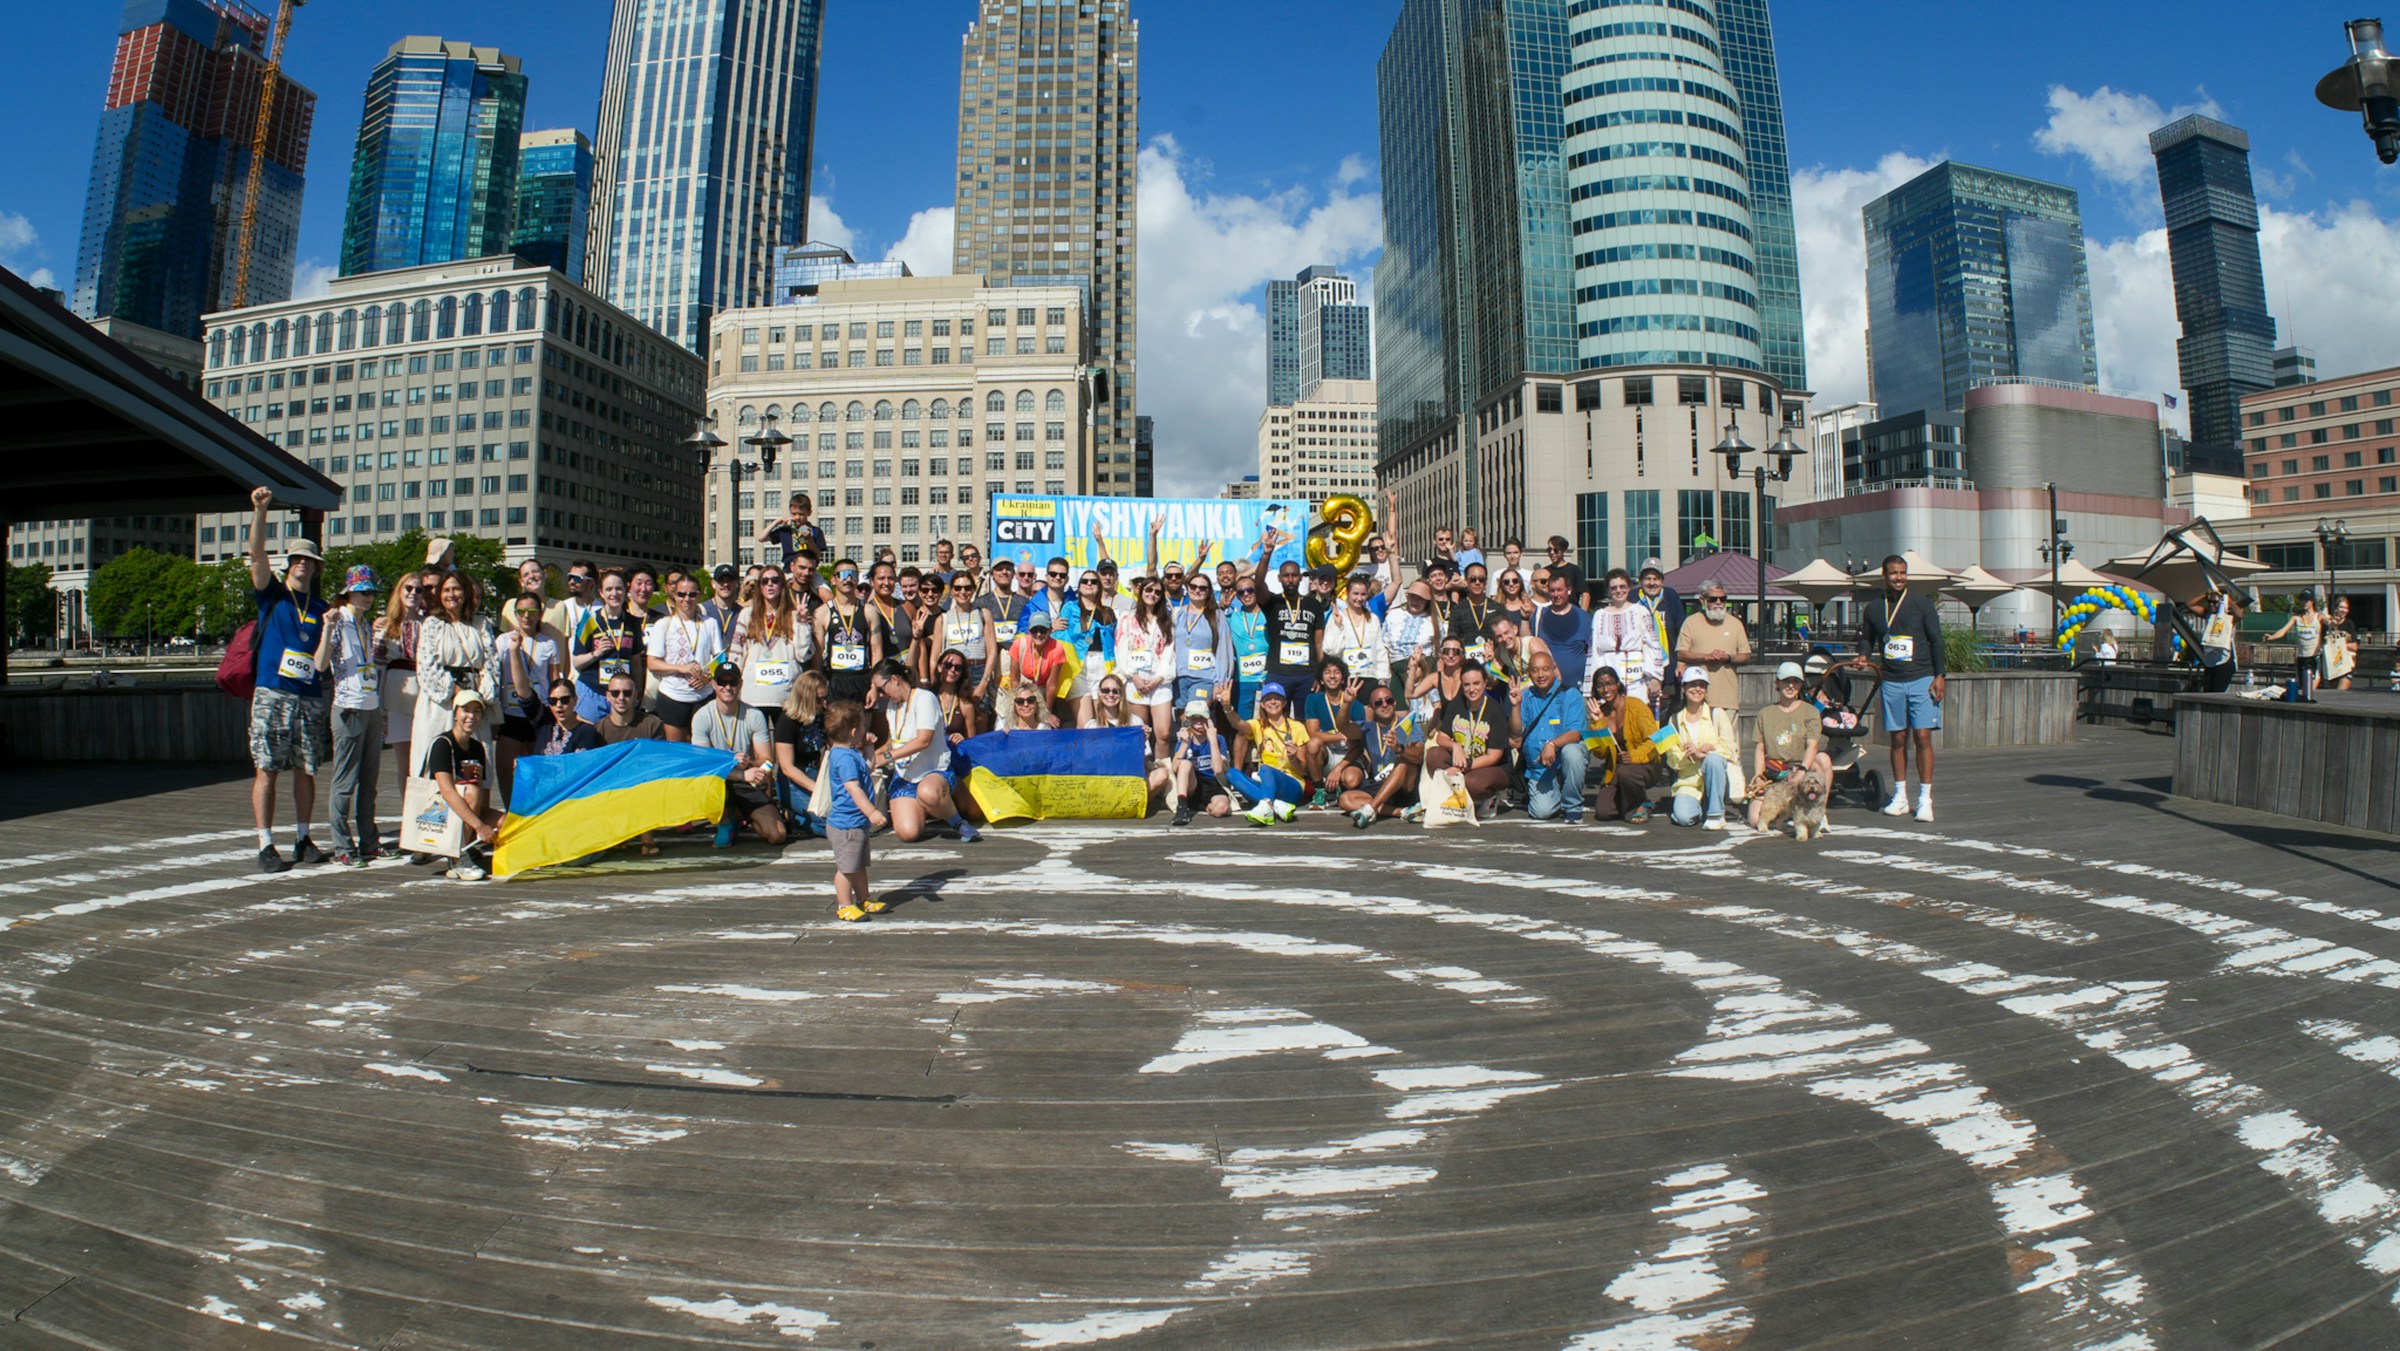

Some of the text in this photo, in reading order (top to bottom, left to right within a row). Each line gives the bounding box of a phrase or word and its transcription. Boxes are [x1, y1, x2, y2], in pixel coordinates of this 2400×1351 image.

[1002, 499, 1051, 509] Ukrainian
[1065, 536, 1089, 567] 5K
[1887, 643, 1907, 651] 063
[837, 653, 857, 661] 010
[1287, 649, 1302, 657] 119
[1242, 660, 1262, 668] 040
[760, 668, 784, 677] 055
